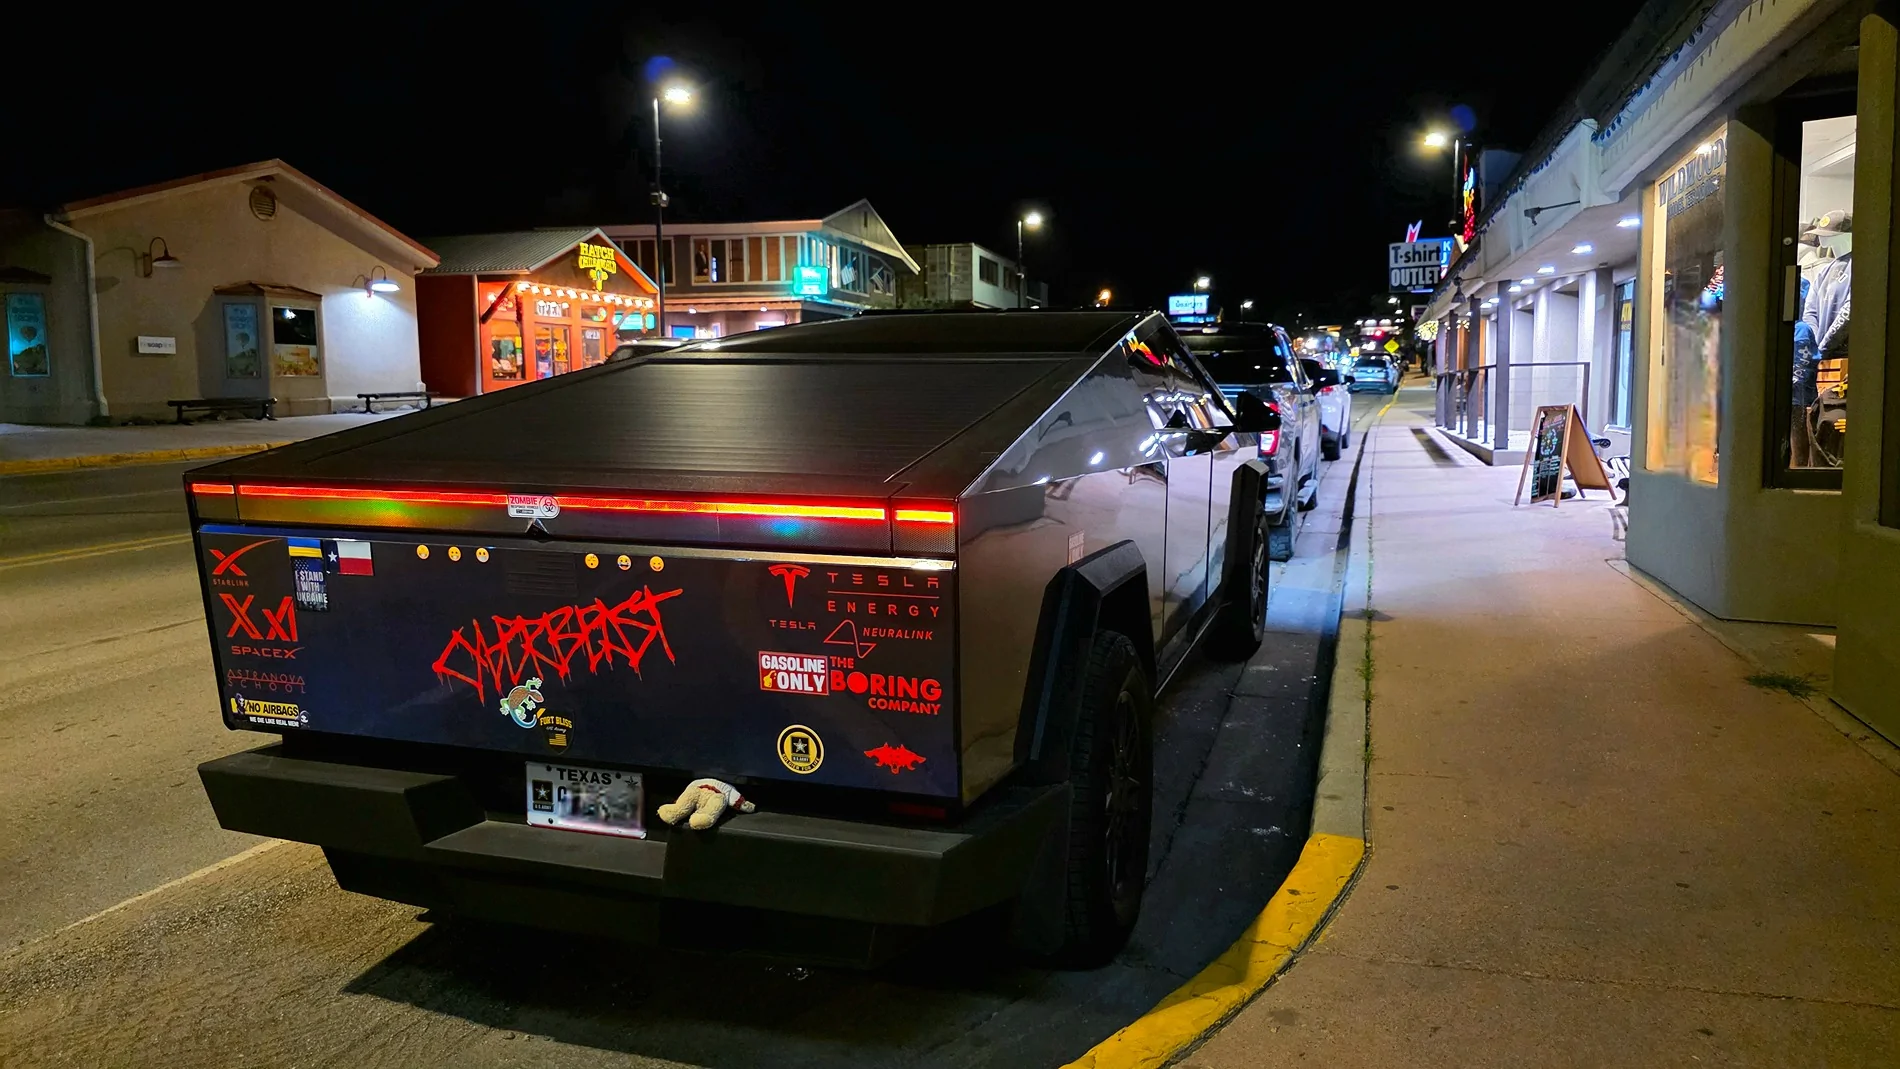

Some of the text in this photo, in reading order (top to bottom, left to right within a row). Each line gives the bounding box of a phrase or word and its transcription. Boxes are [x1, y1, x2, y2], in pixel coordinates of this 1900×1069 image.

[1659, 138, 1727, 207] WILDWOOD
[1390, 266, 1441, 287] OUTLET
[509, 496, 538, 505] ZOMBIE
[212, 578, 250, 587] STARLINK
[299, 570, 324, 582] STAND
[827, 572, 939, 589] TESLA
[300, 581, 320, 592] WITH
[296, 591, 329, 603] UKRAINE
[827, 600, 940, 618] ENERGY
[769, 619, 933, 641] TESLA NEURALINK
[231, 645, 305, 659] SPACEX
[760, 654, 826, 674] GASOLINE
[830, 655, 855, 669] THE
[227, 668, 306, 686] ASTRANOVA
[776, 671, 826, 693] ONLY
[830, 669, 943, 702] BORING
[227, 679, 306, 694] SCHOOL
[248, 702, 299, 717] NO AIRBAGS
[868, 697, 942, 716] COMPANY
[539, 715, 573, 729] FORT BLISS
[556, 768, 612, 785] TEXAS
